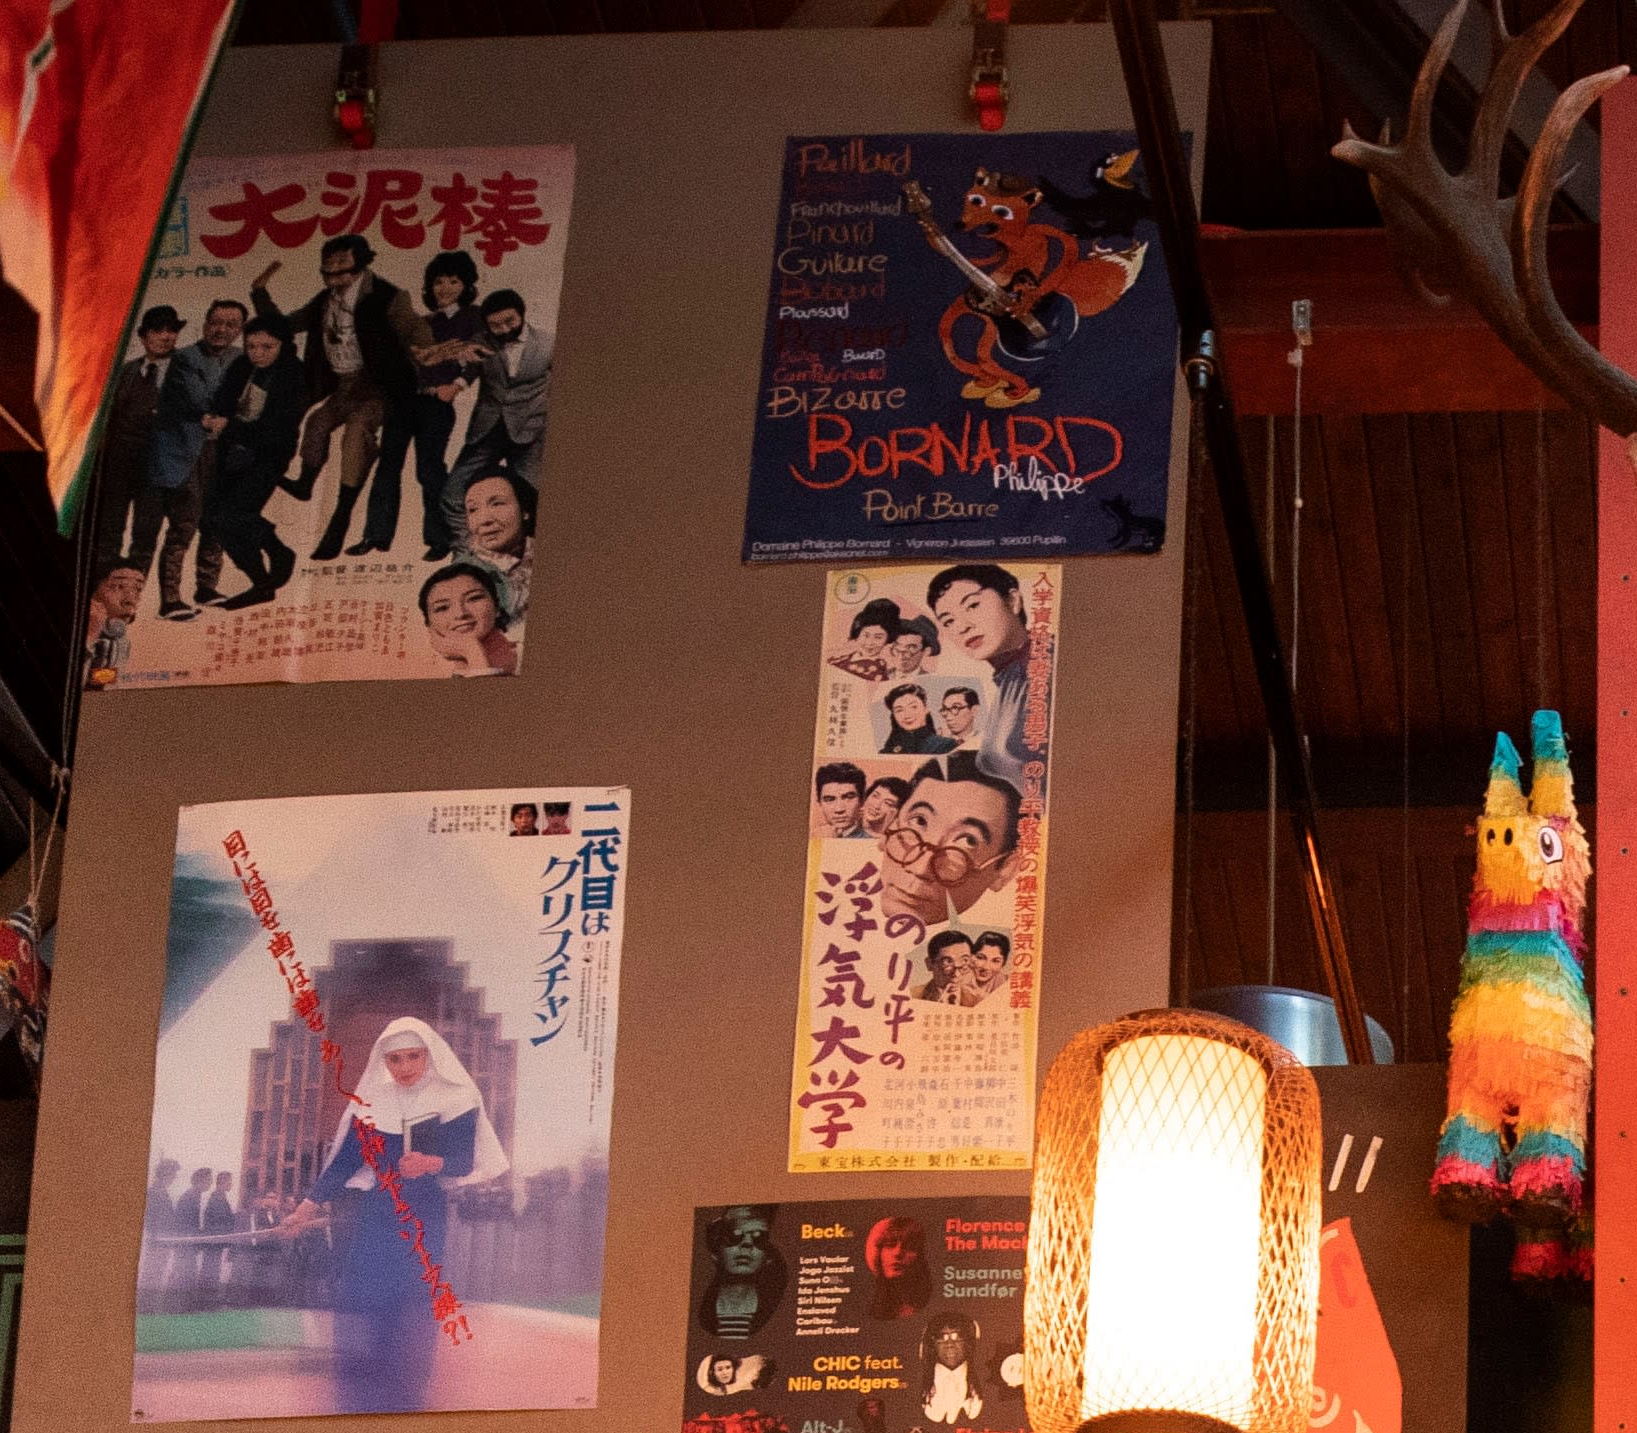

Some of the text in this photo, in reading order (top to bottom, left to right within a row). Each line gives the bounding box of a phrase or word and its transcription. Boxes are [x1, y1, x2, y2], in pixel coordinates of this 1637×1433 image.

[200, 169, 552, 268] 大泥棒
[993, 456, 1085, 498] Philippe
[861, 489, 999, 521] Point Barre
[576, 801, 621, 936] 二代目は
[530, 856, 581, 1048] クリスチャン
[801, 1223, 845, 1239] Beck
[946, 1218, 1025, 1233] Florence
[946, 1236, 977, 1250] The
[944, 1266, 1023, 1280] Susanne
[943, 1284, 1017, 1298] Sundfør
[813, 1355, 903, 1372] CHIC feat.
[788, 1376, 900, 1393] Nile Rodgers
